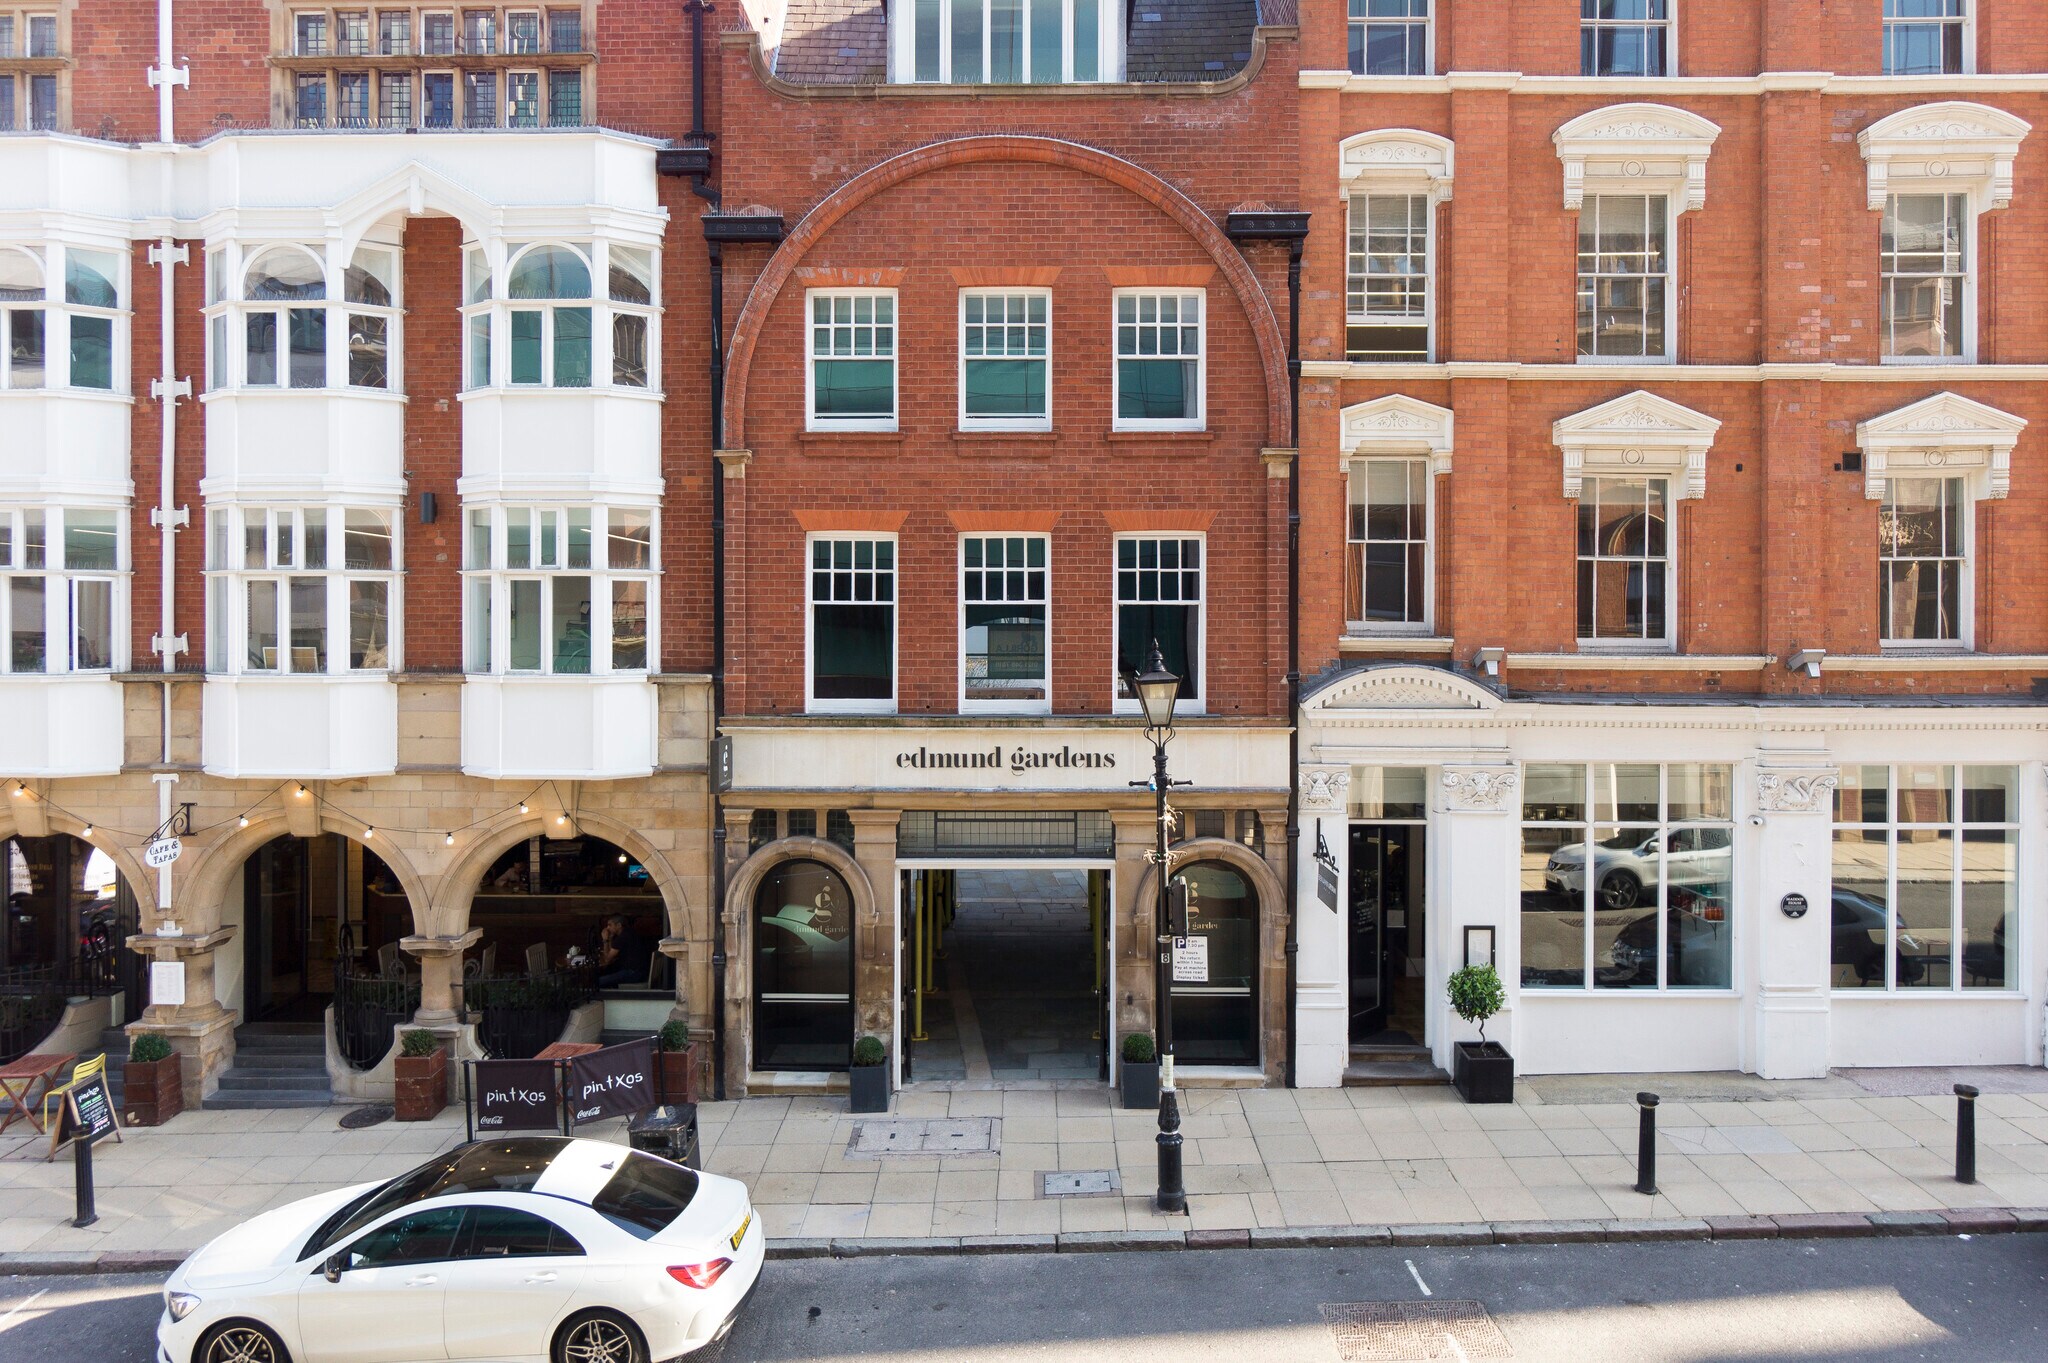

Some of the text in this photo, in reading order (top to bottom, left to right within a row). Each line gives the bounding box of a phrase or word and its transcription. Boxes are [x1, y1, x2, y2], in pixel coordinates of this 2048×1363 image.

[896, 746, 1116, 776] edmund gardens
[171, 841, 178, 849] &
[153, 852, 177, 864] TAPAS
[793, 925, 822, 933] dmund
[1178, 939, 1185, 948] P
